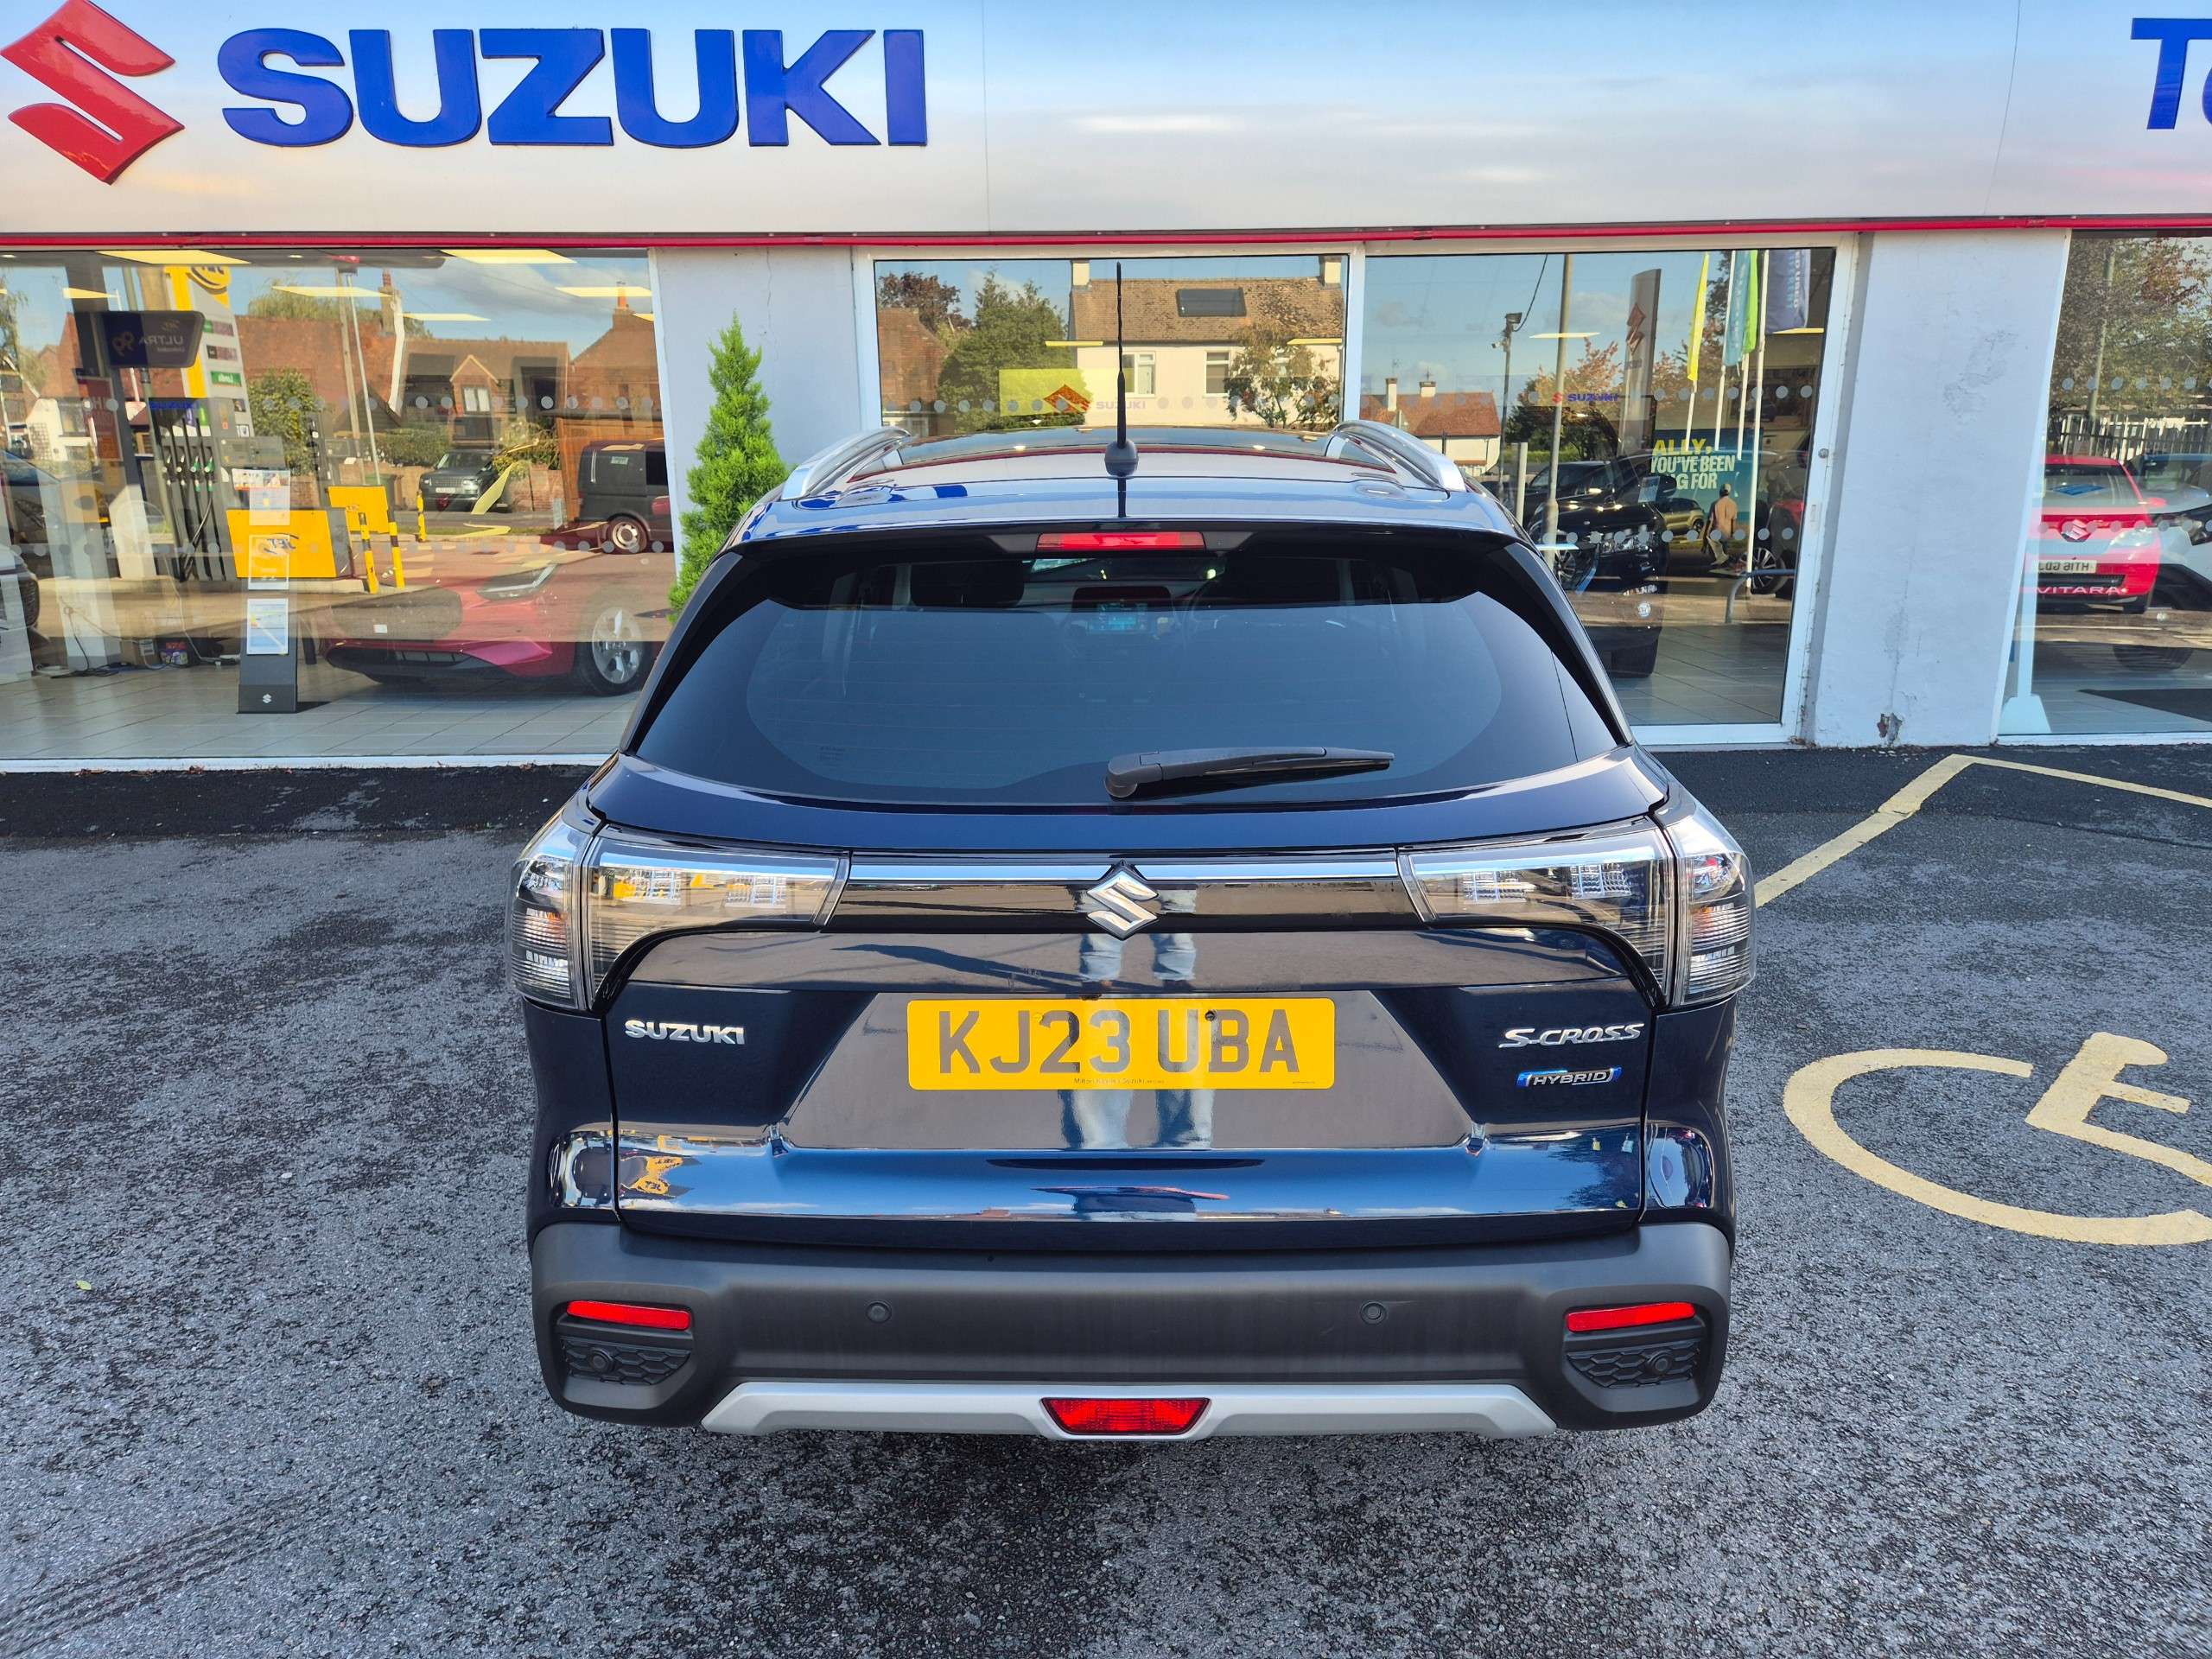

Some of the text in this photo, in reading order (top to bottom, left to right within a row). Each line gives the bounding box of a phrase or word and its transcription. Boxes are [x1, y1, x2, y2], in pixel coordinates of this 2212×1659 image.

[2131, 17, 2212, 130] T
[218, 28, 926, 148] SUZUKI
[1096, 400, 1147, 410] SUUKI
[1650, 454, 1736, 474] YOU'VE BEEN
[1691, 472, 1718, 490] FOR
[2037, 586, 2121, 594] VITARA
[625, 1020, 745, 1045] SUZUKI
[939, 1008, 1300, 1075] KJ23 UBA
[1533, 1071, 1607, 1085] HYBRID
